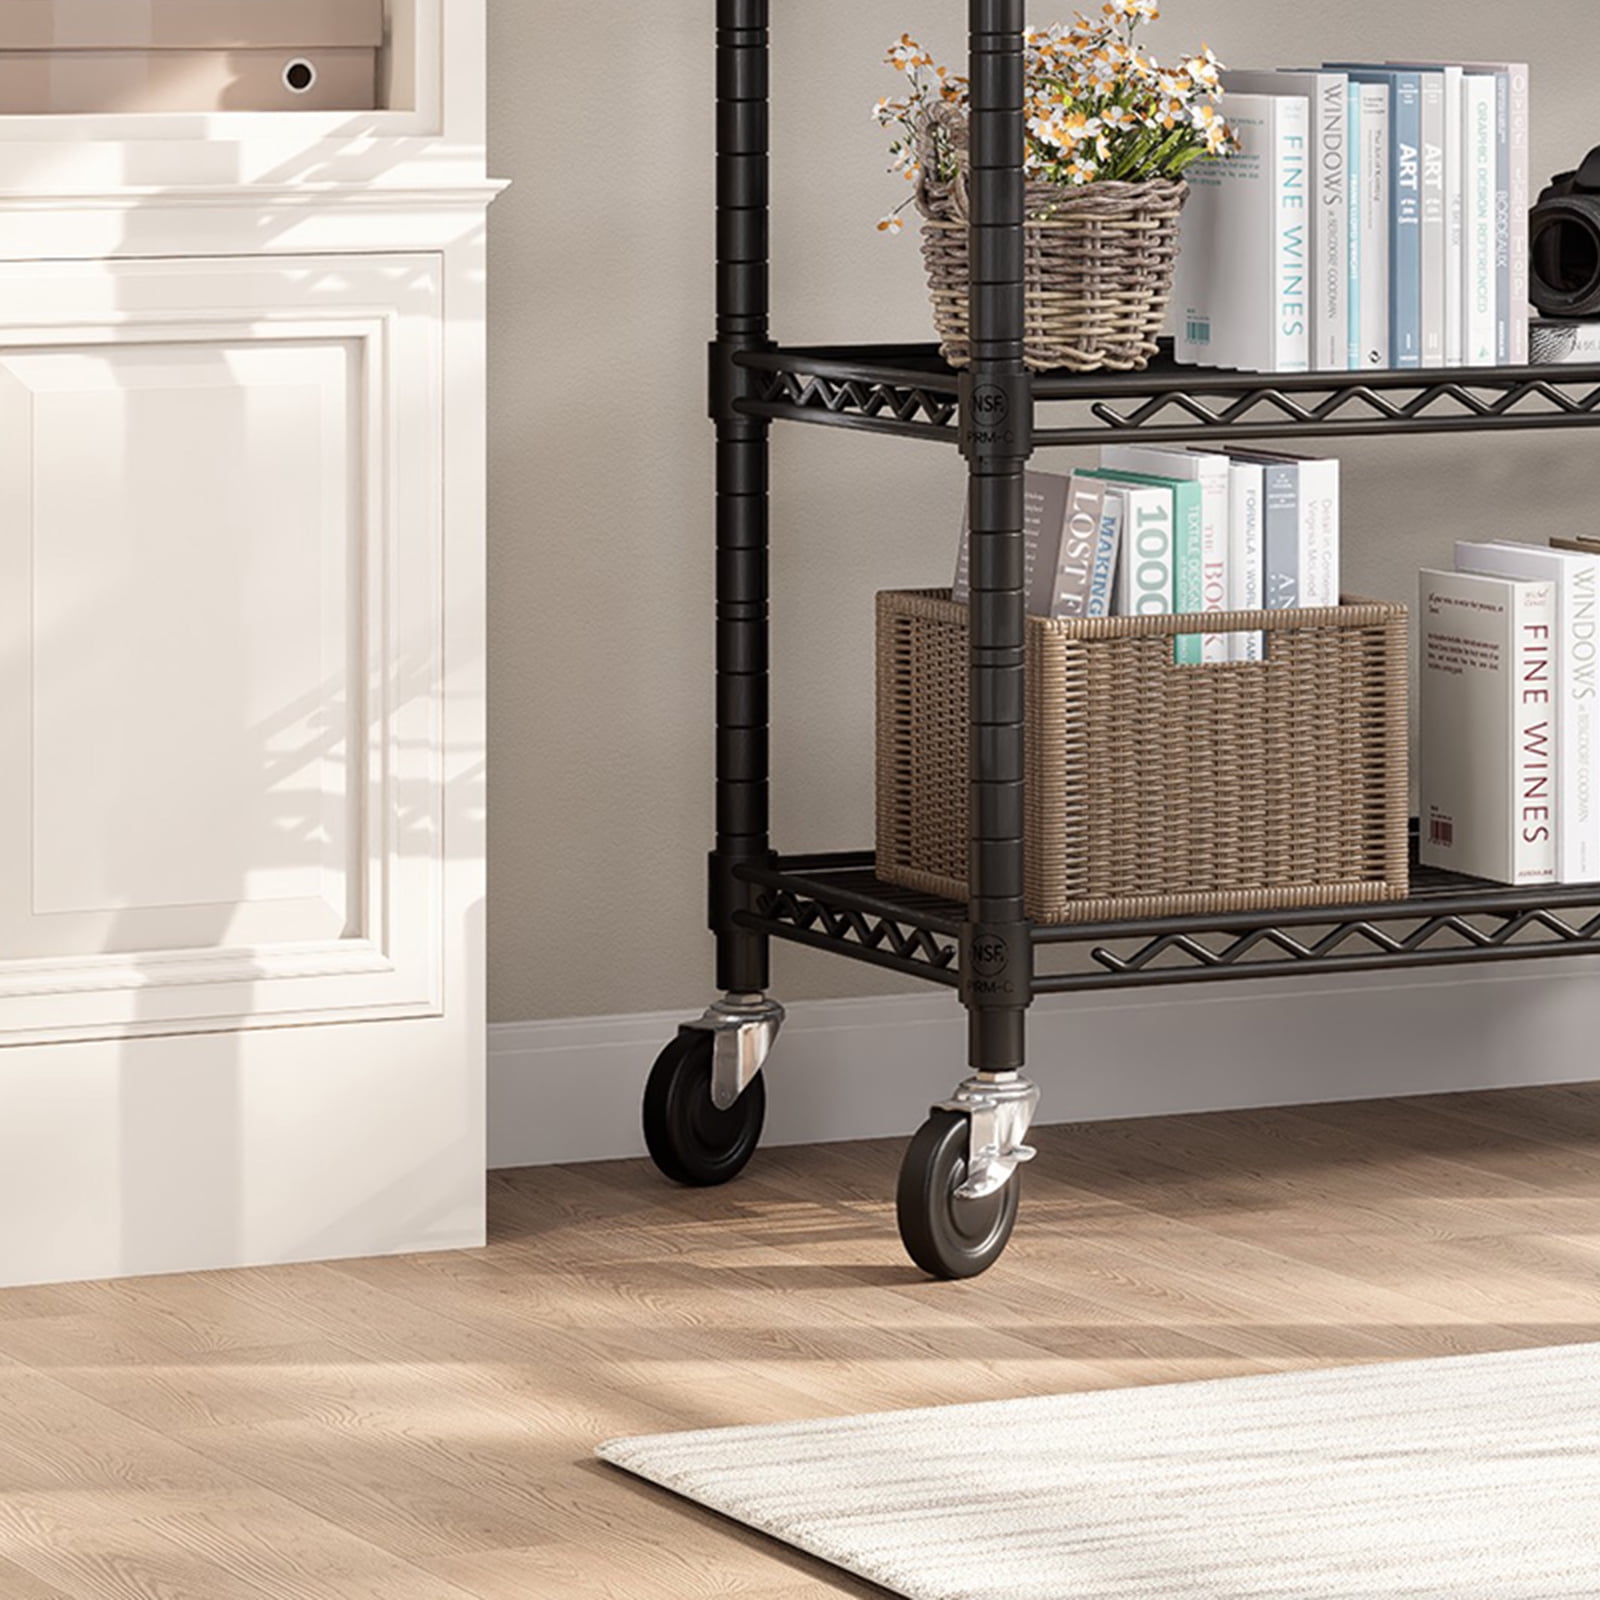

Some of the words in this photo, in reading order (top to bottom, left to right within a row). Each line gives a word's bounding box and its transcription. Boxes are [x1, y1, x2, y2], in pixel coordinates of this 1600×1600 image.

[1283, 136, 1304, 209] FINE
[1322, 83, 1343, 206] WINDOWS
[1399, 143, 1418, 190] ART
[1424, 143, 1442, 190] ART
[1477, 102, 1488, 163] GRAPHIC
[1477, 167, 1488, 217] DESIGN
[1283, 226, 1304, 337] WINES
[1477, 222, 1488, 313] REFERENCED
[1063, 491, 1099, 585] LOST
[1246, 489, 1256, 555] FORMULA
[1090, 516, 1117, 615] MAKING
[1523, 624, 1549, 703] FINE
[1571, 567, 1596, 701] WINDOWS
[1523, 722, 1549, 843] WINES
